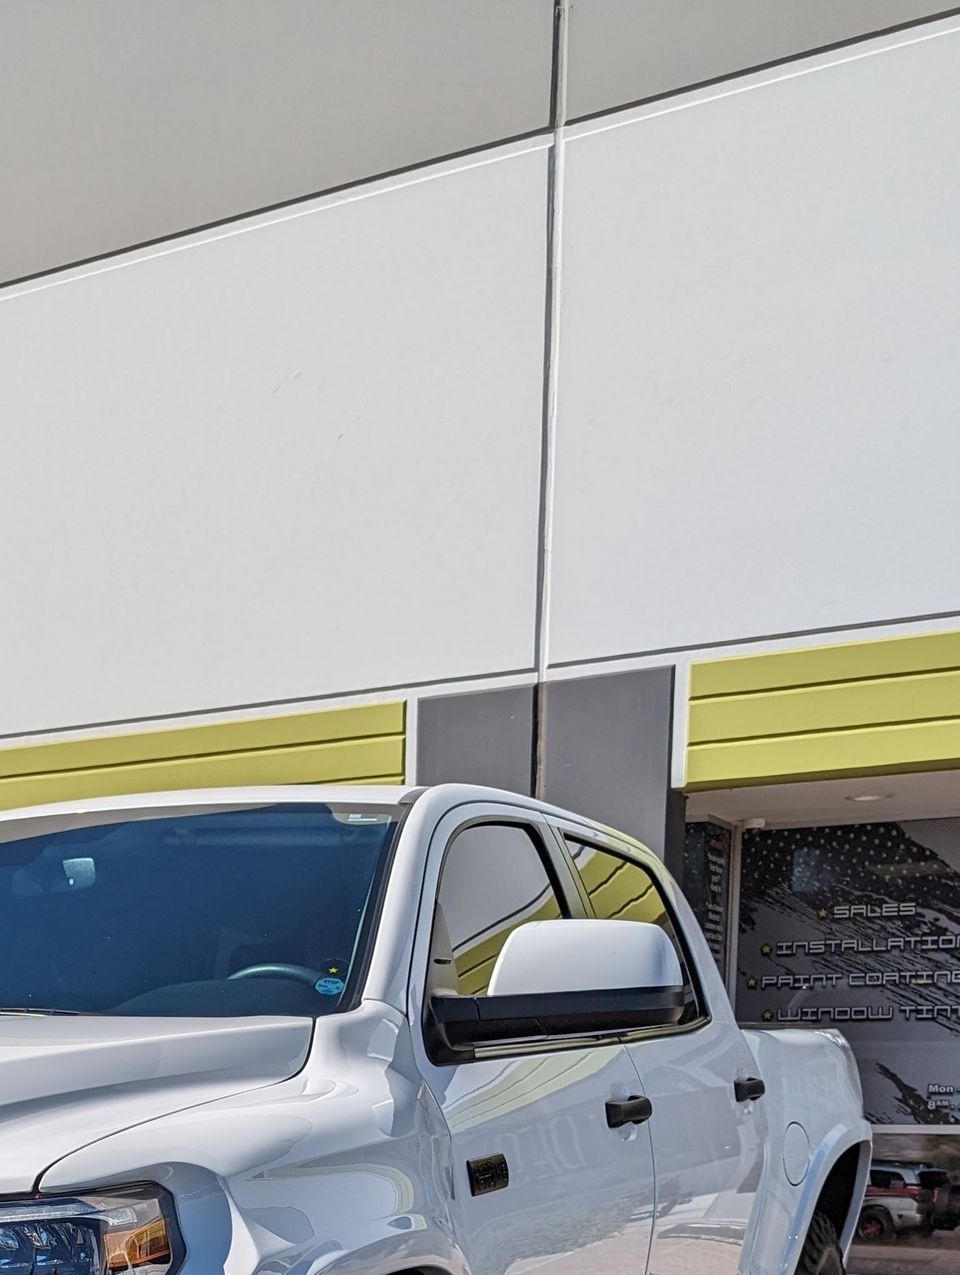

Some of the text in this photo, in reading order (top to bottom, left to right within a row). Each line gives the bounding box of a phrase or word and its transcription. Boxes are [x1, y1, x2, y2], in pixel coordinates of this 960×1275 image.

[833, 903, 916, 918] SALES
[776, 936, 960, 955] INSTALLATIO
[761, 973, 842, 988] PAINT
[778, 1006, 893, 1020] WINDOW
[928, 1084, 954, 1093] Mon
